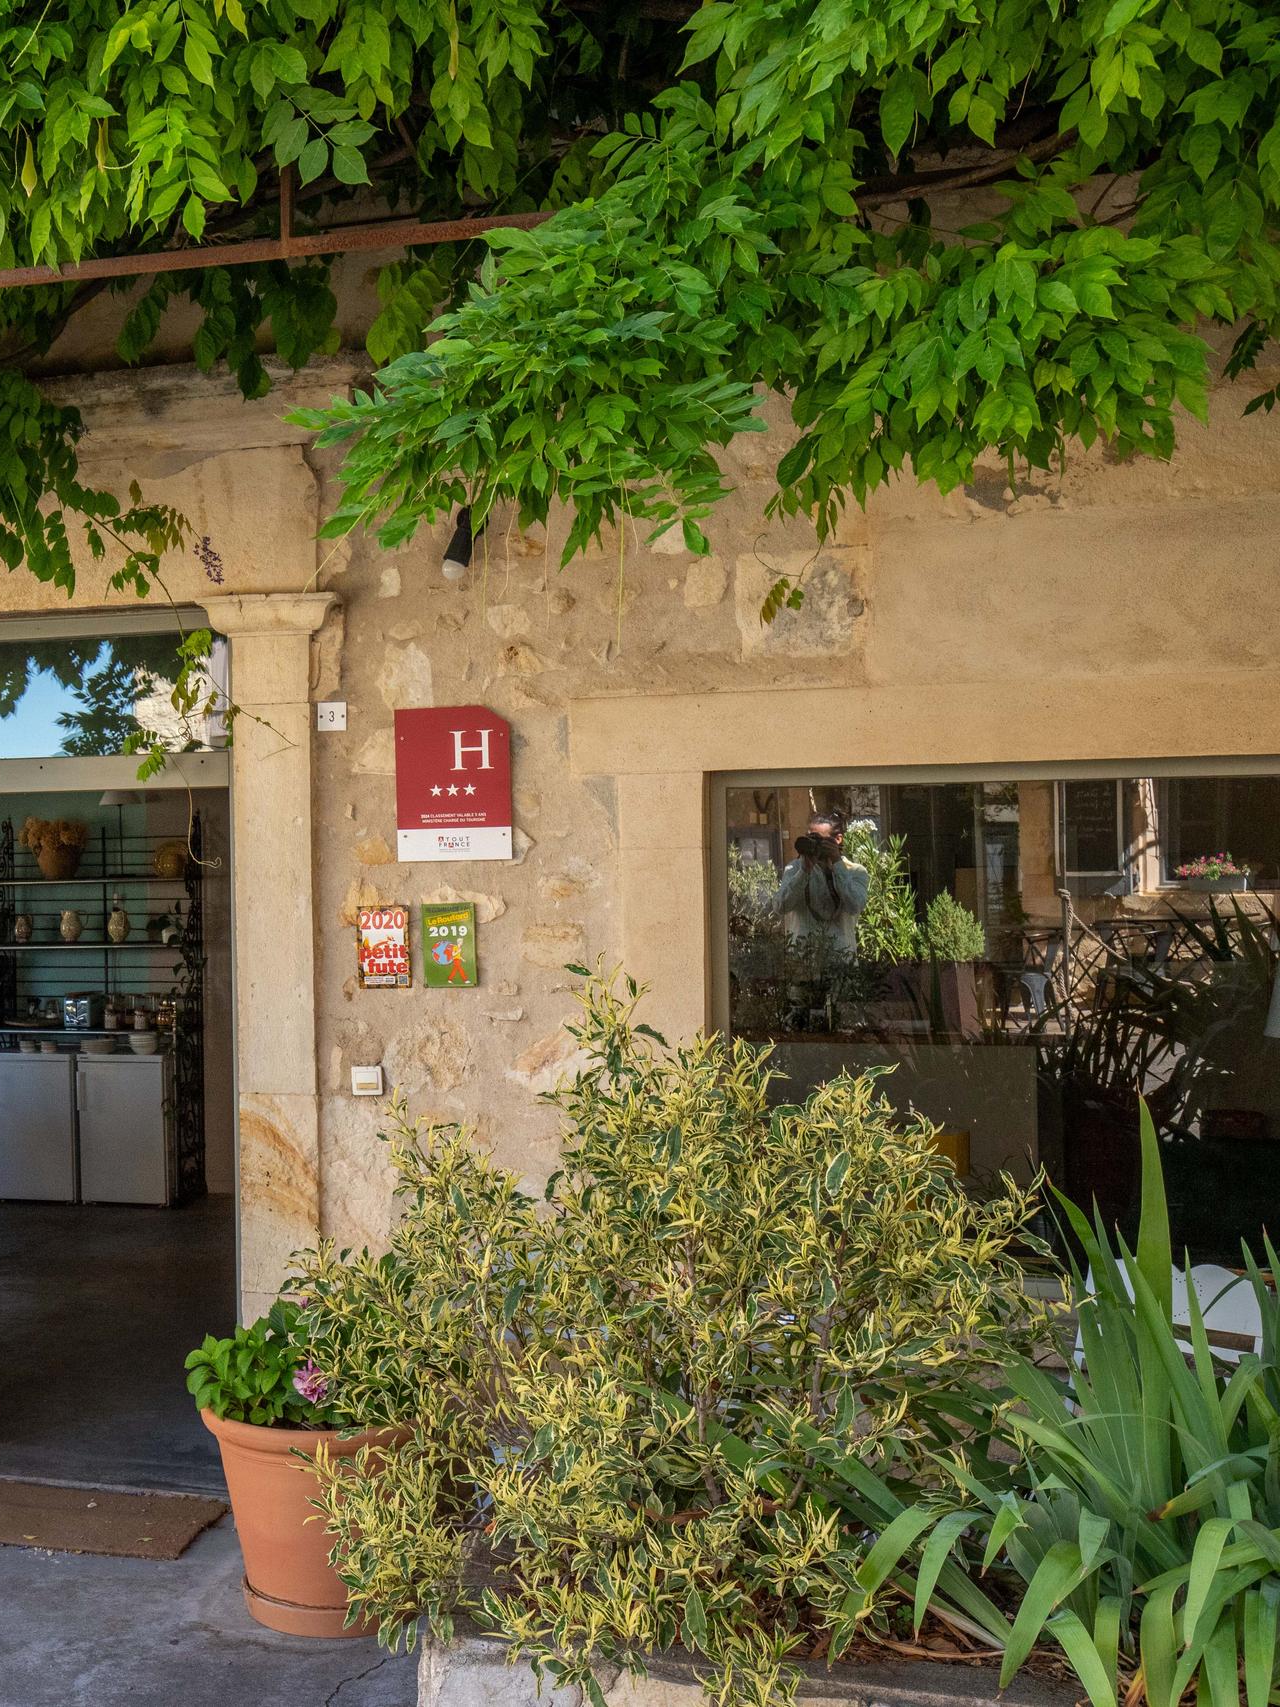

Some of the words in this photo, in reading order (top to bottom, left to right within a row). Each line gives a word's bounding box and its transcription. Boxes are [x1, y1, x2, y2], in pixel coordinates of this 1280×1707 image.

[328, 711, 336, 723] 3
[449, 729, 495, 771] H
[360, 910, 406, 930] 2020
[427, 918, 437, 926] Le
[436, 911, 469, 924] Routard
[428, 925, 468, 937] 2019
[360, 943, 408, 962] petit
